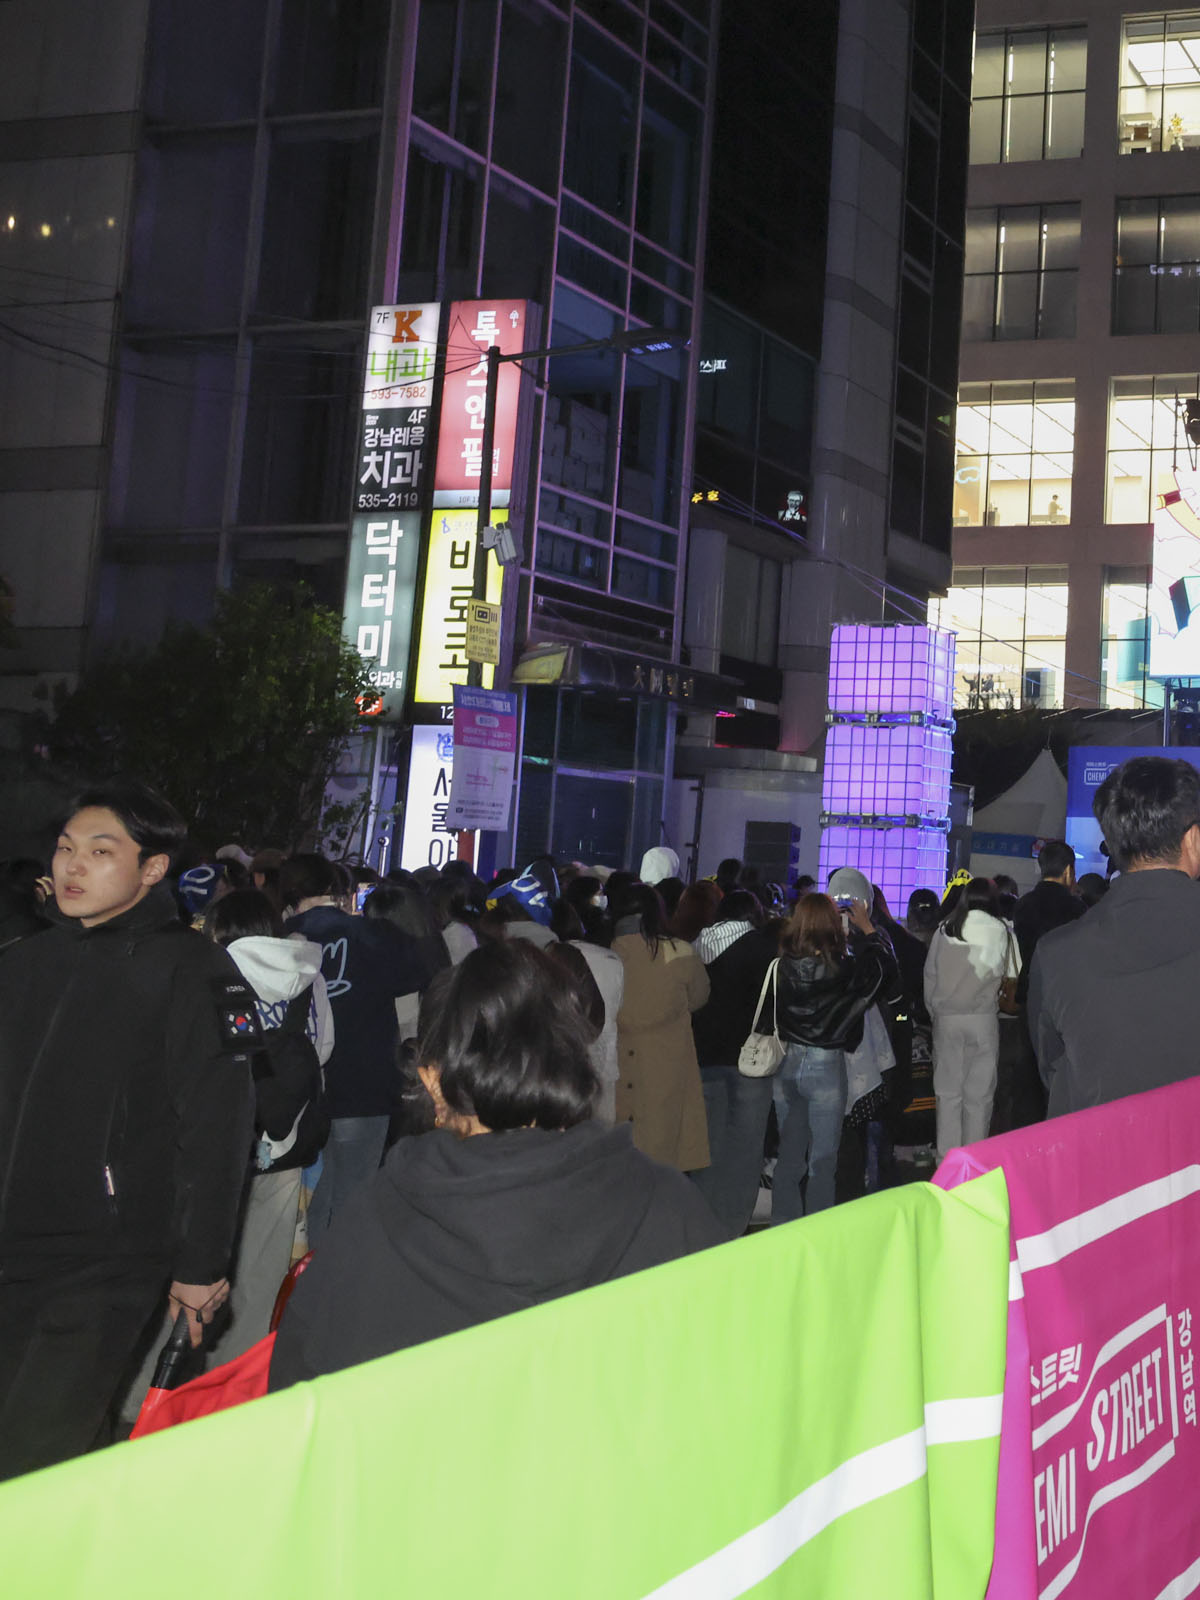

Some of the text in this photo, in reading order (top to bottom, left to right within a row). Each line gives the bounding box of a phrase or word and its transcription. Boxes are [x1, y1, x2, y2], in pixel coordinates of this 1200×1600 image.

[376, 312, 390, 325] 7F
[391, 310, 422, 343] K
[370, 347, 432, 384] 내과
[370, 385, 427, 401] 593-7582
[407, 408, 428, 425] 4F
[364, 426, 425, 448] 강남레옹
[359, 449, 423, 489] 치과
[358, 492, 419, 508] 535-2119
[356, 519, 404, 667] 닥터미
[1177, 1307, 1198, 1428] 강남역
[1086, 1347, 1166, 1473] STREET
